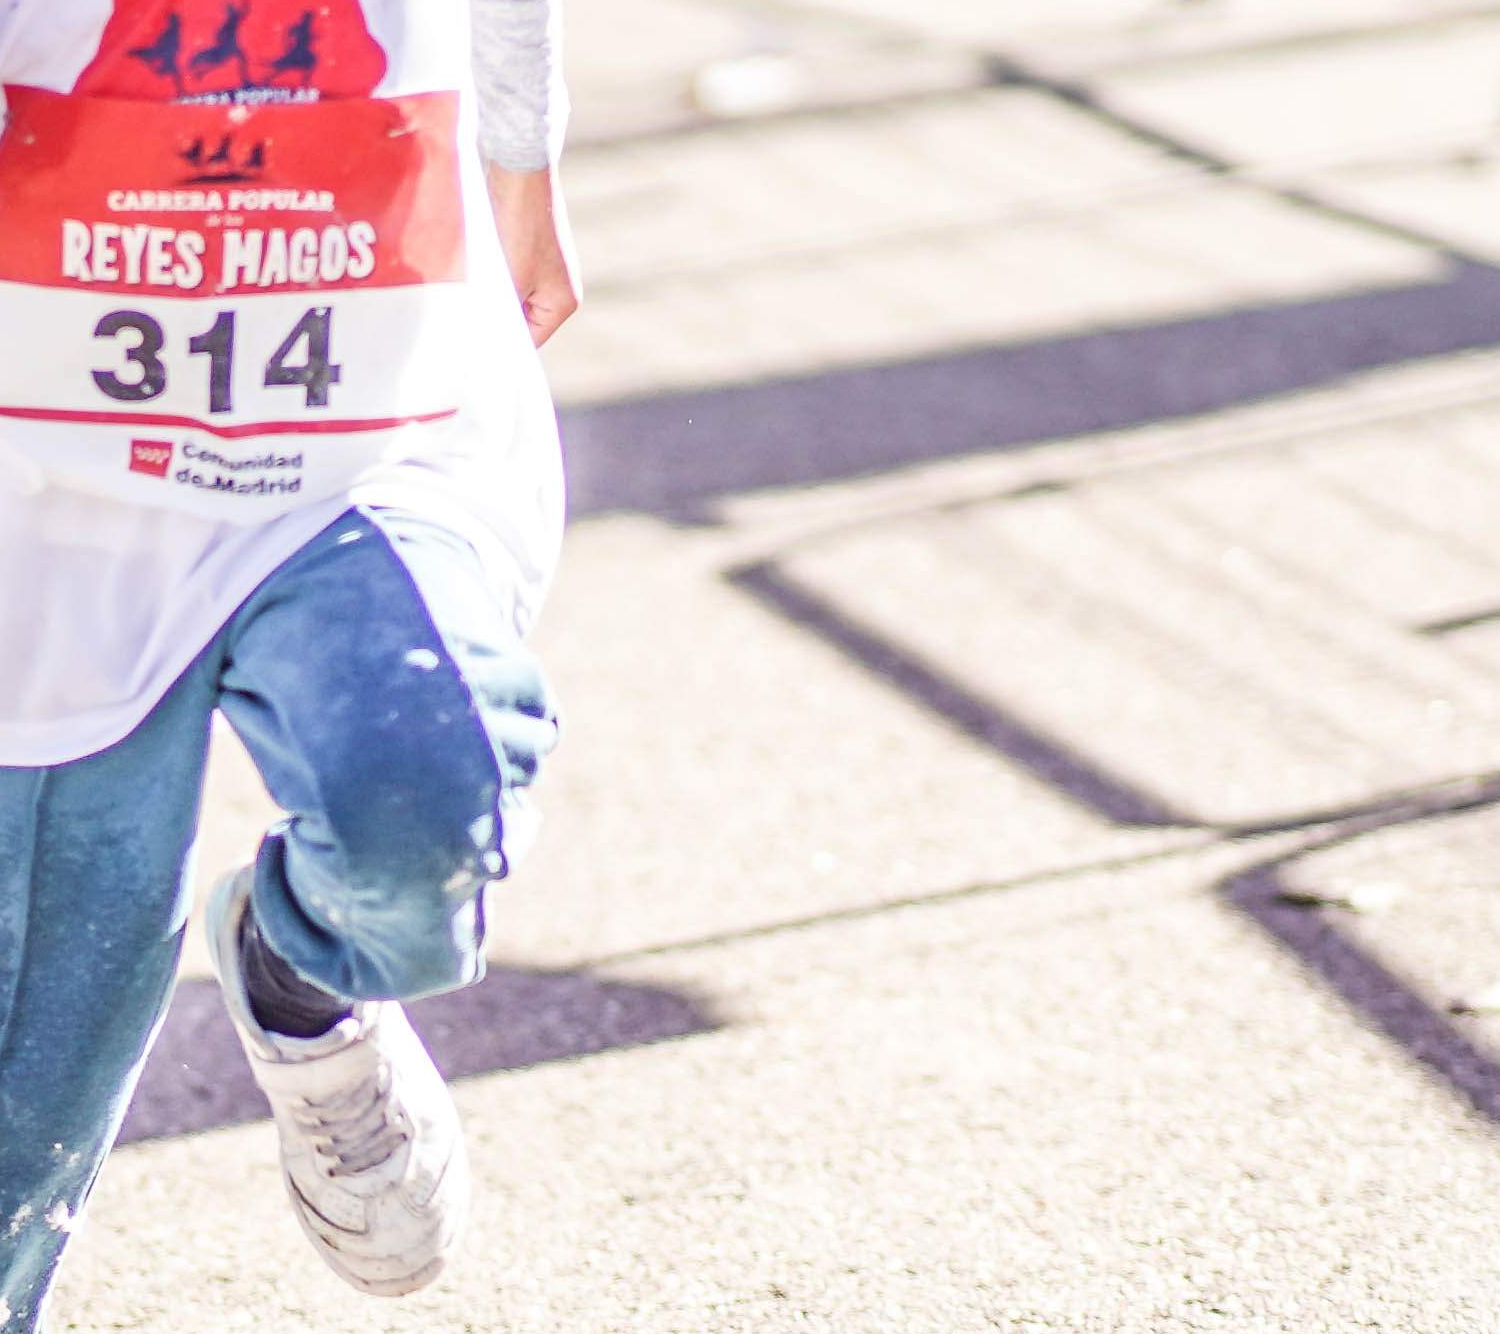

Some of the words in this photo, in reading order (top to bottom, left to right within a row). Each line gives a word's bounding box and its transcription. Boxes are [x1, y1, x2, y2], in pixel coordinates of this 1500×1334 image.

[107, 190, 223, 211] CARRERA
[227, 189, 335, 211] POPULAR
[61, 218, 205, 289] REYES
[217, 220, 376, 291] MAGOS
[91, 306, 341, 413] 314
[182, 442, 303, 470] Comunidad
[214, 474, 302, 495] Madrid
